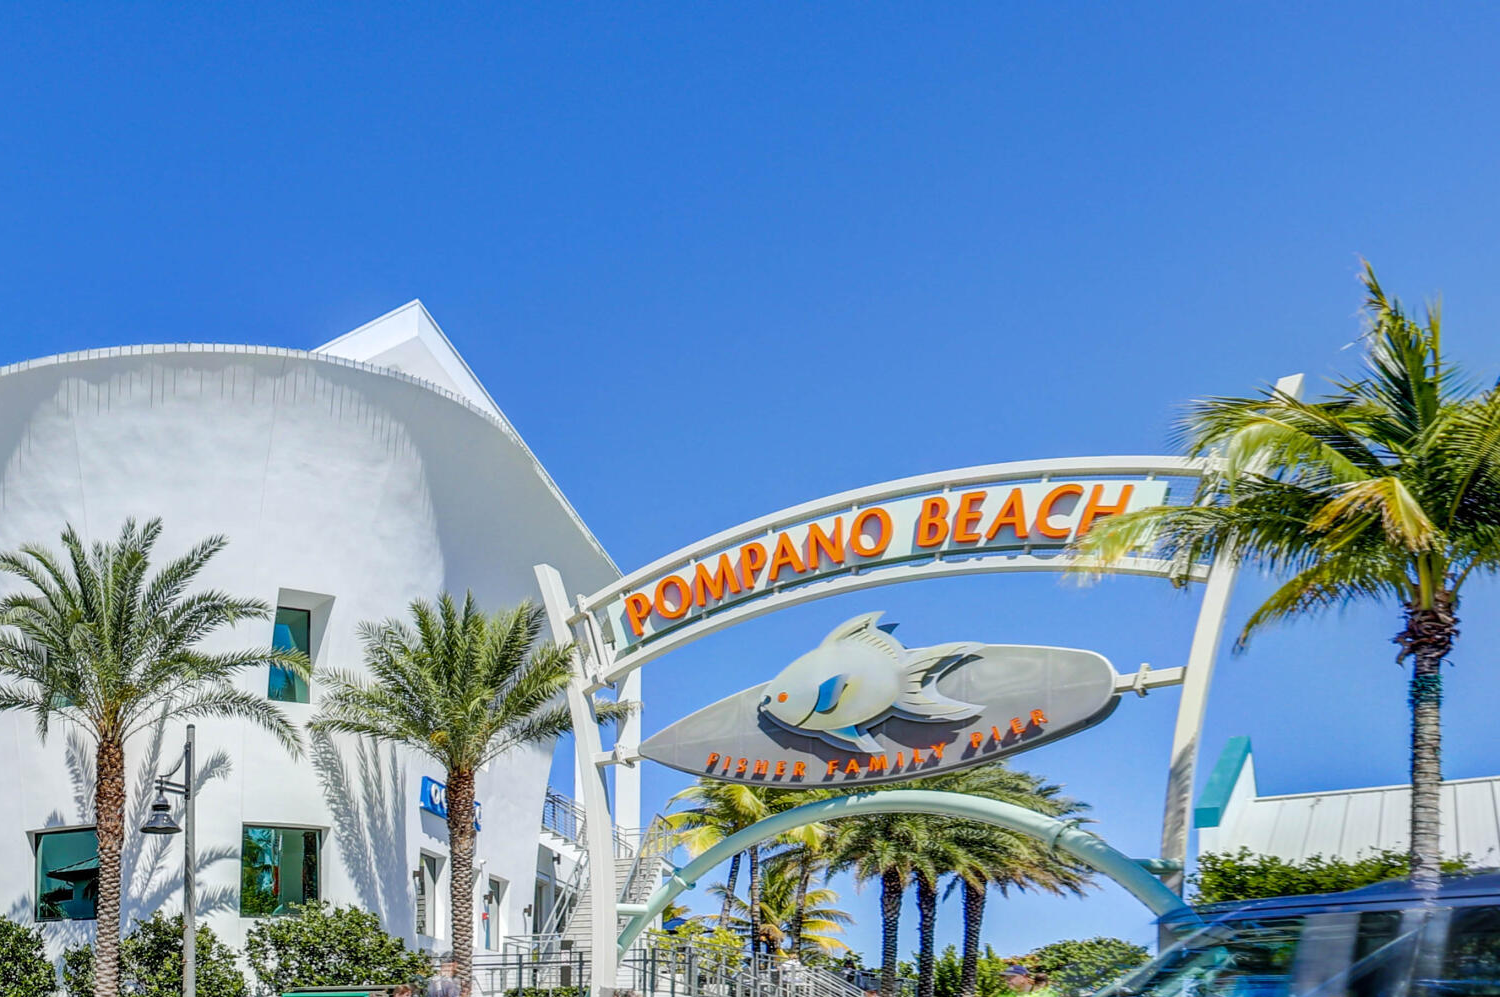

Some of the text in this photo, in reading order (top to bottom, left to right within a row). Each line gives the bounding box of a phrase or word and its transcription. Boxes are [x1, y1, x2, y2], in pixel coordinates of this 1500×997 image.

[624, 484, 1134, 636] POMPANO BEACH
[706, 708, 1048, 776] FISHER FAMILY PIER
